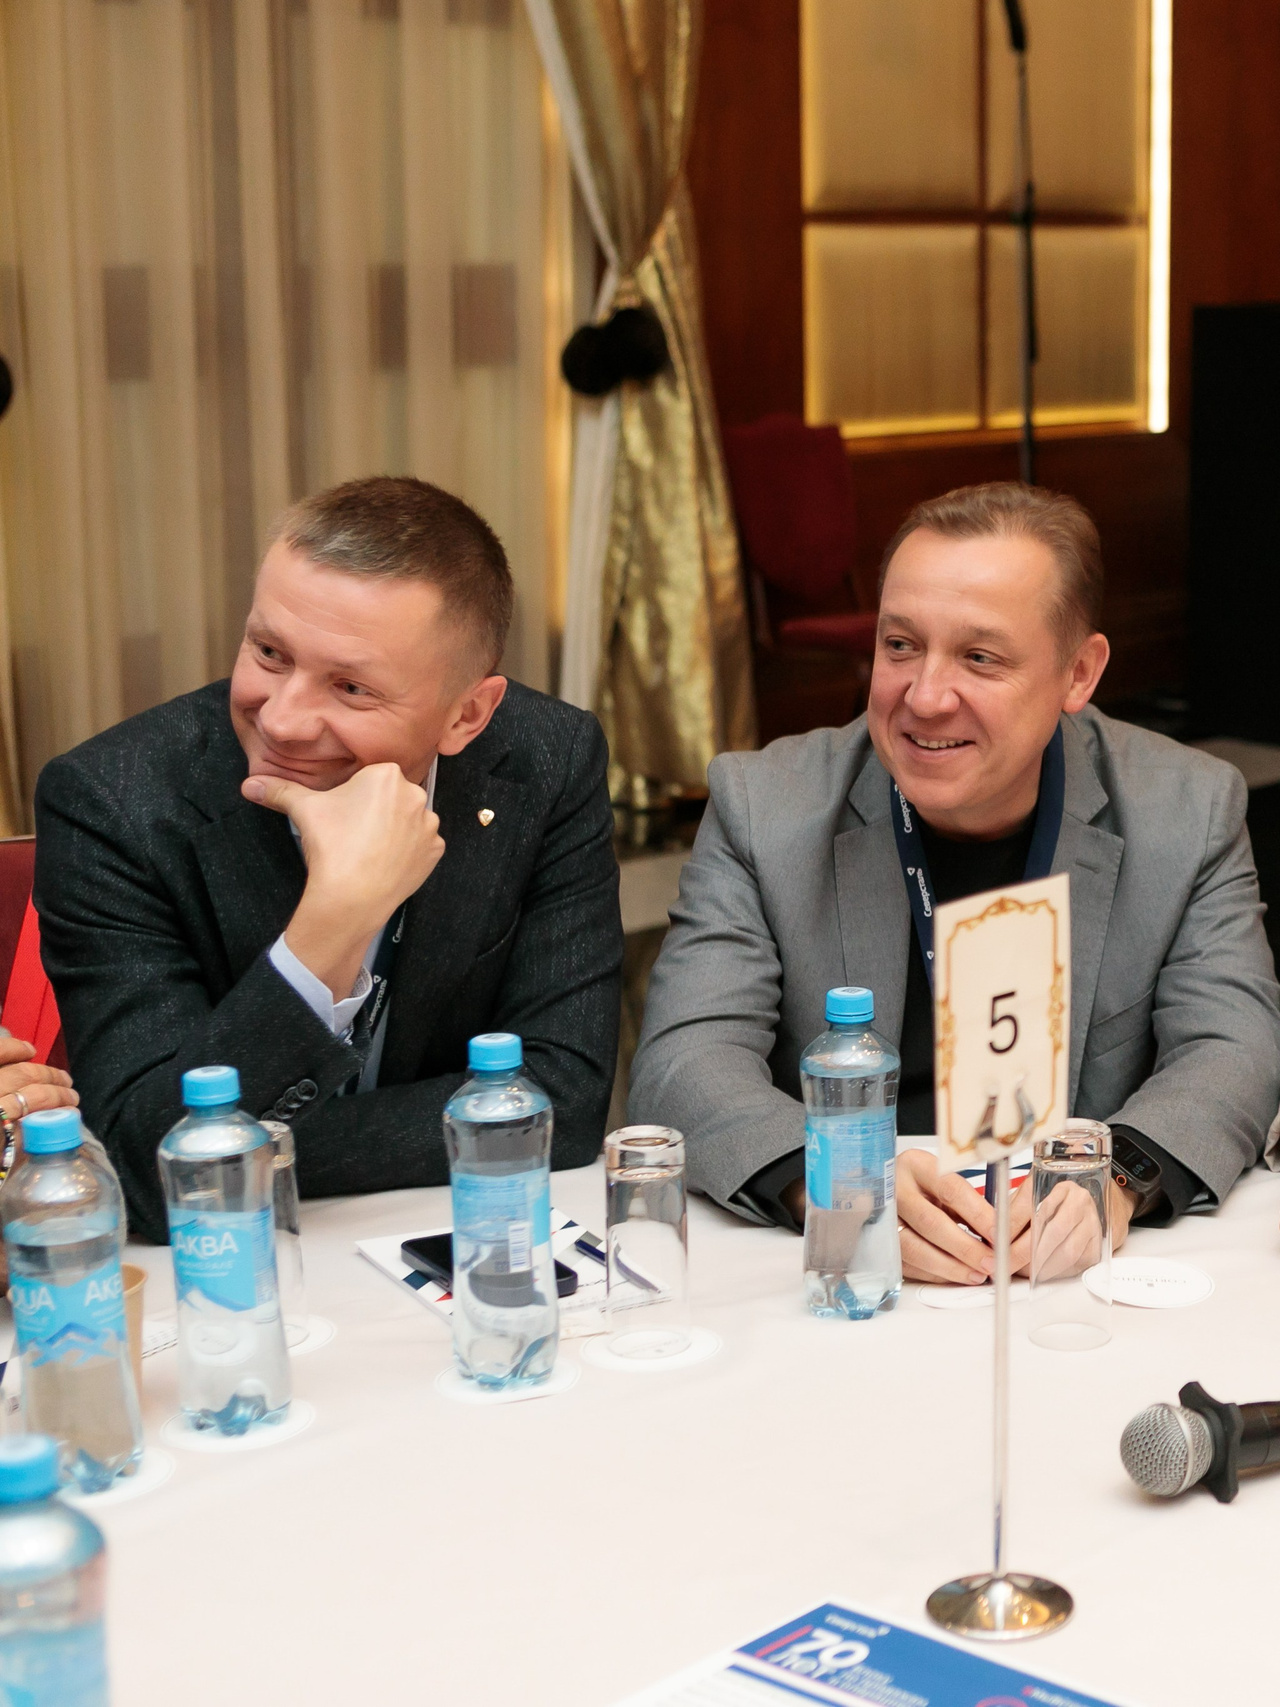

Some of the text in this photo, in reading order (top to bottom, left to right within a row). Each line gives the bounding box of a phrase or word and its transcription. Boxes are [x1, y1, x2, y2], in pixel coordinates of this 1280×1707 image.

[916, 867, 933, 918] Северсталь
[988, 990, 1019, 1055] 5
[174, 1230, 240, 1260] АКВА
[786, 1627, 870, 1670] 70
